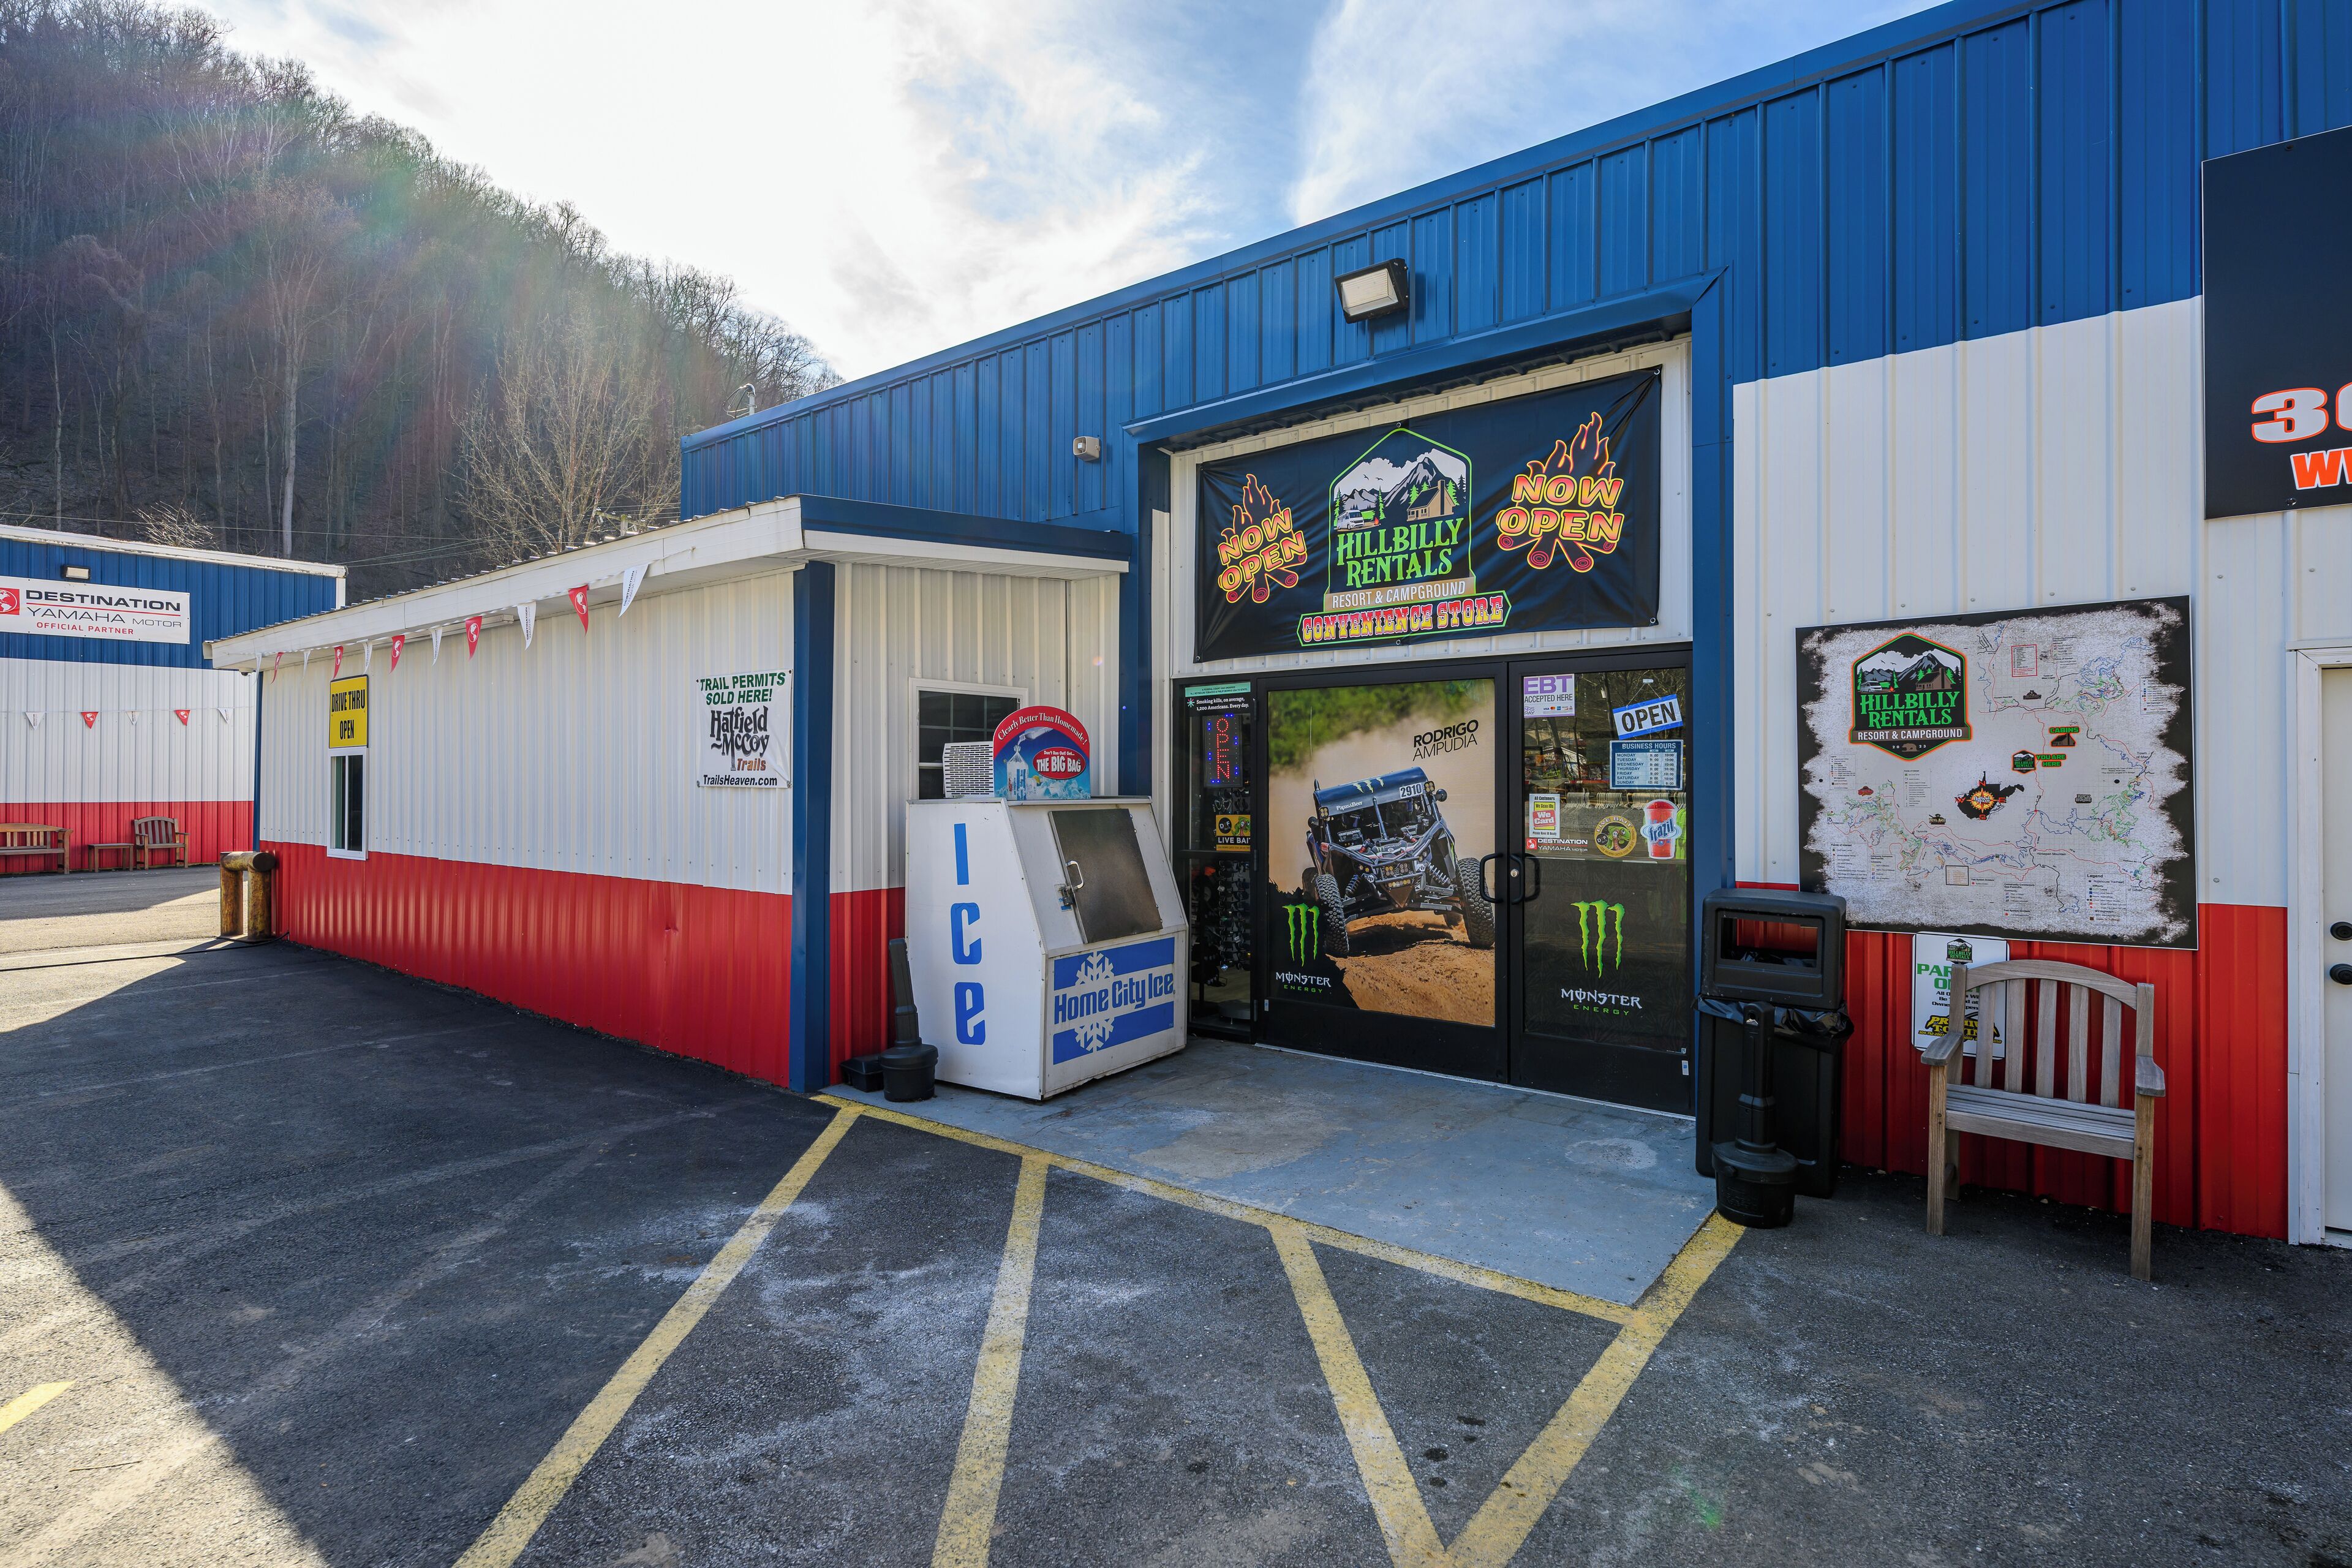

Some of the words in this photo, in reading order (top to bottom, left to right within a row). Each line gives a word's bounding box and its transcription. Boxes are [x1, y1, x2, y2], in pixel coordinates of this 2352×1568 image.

[2252, 382, 2352, 443] 3
[2290, 447, 2352, 490] W
[1511, 473, 1624, 508] NOW
[1218, 507, 1292, 565] NOW
[1498, 506, 1624, 543] OPEN
[1336, 518, 1464, 565] HILLBILLY
[1221, 530, 1306, 591] OPEN
[1346, 548, 1452, 588] RENTALS
[26, 590, 181, 611] DESTINATION
[1332, 591, 1371, 609] RESORT
[1375, 590, 1383, 603] &
[1386, 581, 1466, 603] CAMPGROUND
[27, 607, 126, 624] YAMAHA
[132, 618, 181, 628] MOTOR
[37, 622, 83, 631] OFFICIAL
[88, 626, 134, 635] PARTNER
[1302, 604, 1433, 643] CONVENIENCE
[1437, 595, 1504, 628] STORE
[700, 677, 729, 691] TRAIL
[733, 673, 786, 688] PERMITS
[1524, 675, 1572, 695] EBT
[332, 692, 347, 712] DRIVE
[348, 689, 365, 710] THRU
[706, 692, 734, 705] SOLD
[737, 688, 772, 703] HERE!
[1860, 692, 1960, 715] HILLBILLY
[710, 706, 769, 741] Hatfield
[998, 719, 1019, 740] Clearly
[1019, 715, 1038, 725] Better
[1039, 712, 1054, 723] Than
[1622, 701, 1676, 732] OPEN
[1869, 709, 1952, 729] RENTALS
[340, 720, 354, 740] OPEN
[1414, 719, 1479, 747] RODRIGO
[1858, 731, 1890, 741] RESORT
[1892, 731, 1898, 739] &
[1901, 729, 1962, 739] CAMPGROUND
[722, 733, 769, 763] McCoy
[1216, 718, 1229, 779] OPEN
[1412, 733, 1477, 761] AMPUDIA
[737, 758, 766, 771] Trails
[1037, 758, 1049, 772] THE
[1051, 756, 1066, 772] BIG
[1068, 758, 1081, 772] BAG
[703, 775, 777, 786] TrailsHeaven.com
[1400, 786, 1422, 797] 2910
[1596, 818, 1611, 832] LIVE
[1613, 816, 1632, 827] BAIT
[1649, 819, 1675, 842] frazil
[1276, 971, 1331, 987] MONSTER
[1284, 984, 1322, 993] ENERGY
[1054, 988, 1109, 1025] Home
[1112, 977, 1146, 1009] City
[1148, 973, 1174, 999] Ice
[1561, 988, 1643, 1009] MONSTER
[1574, 1005, 1629, 1016] ENERGY
